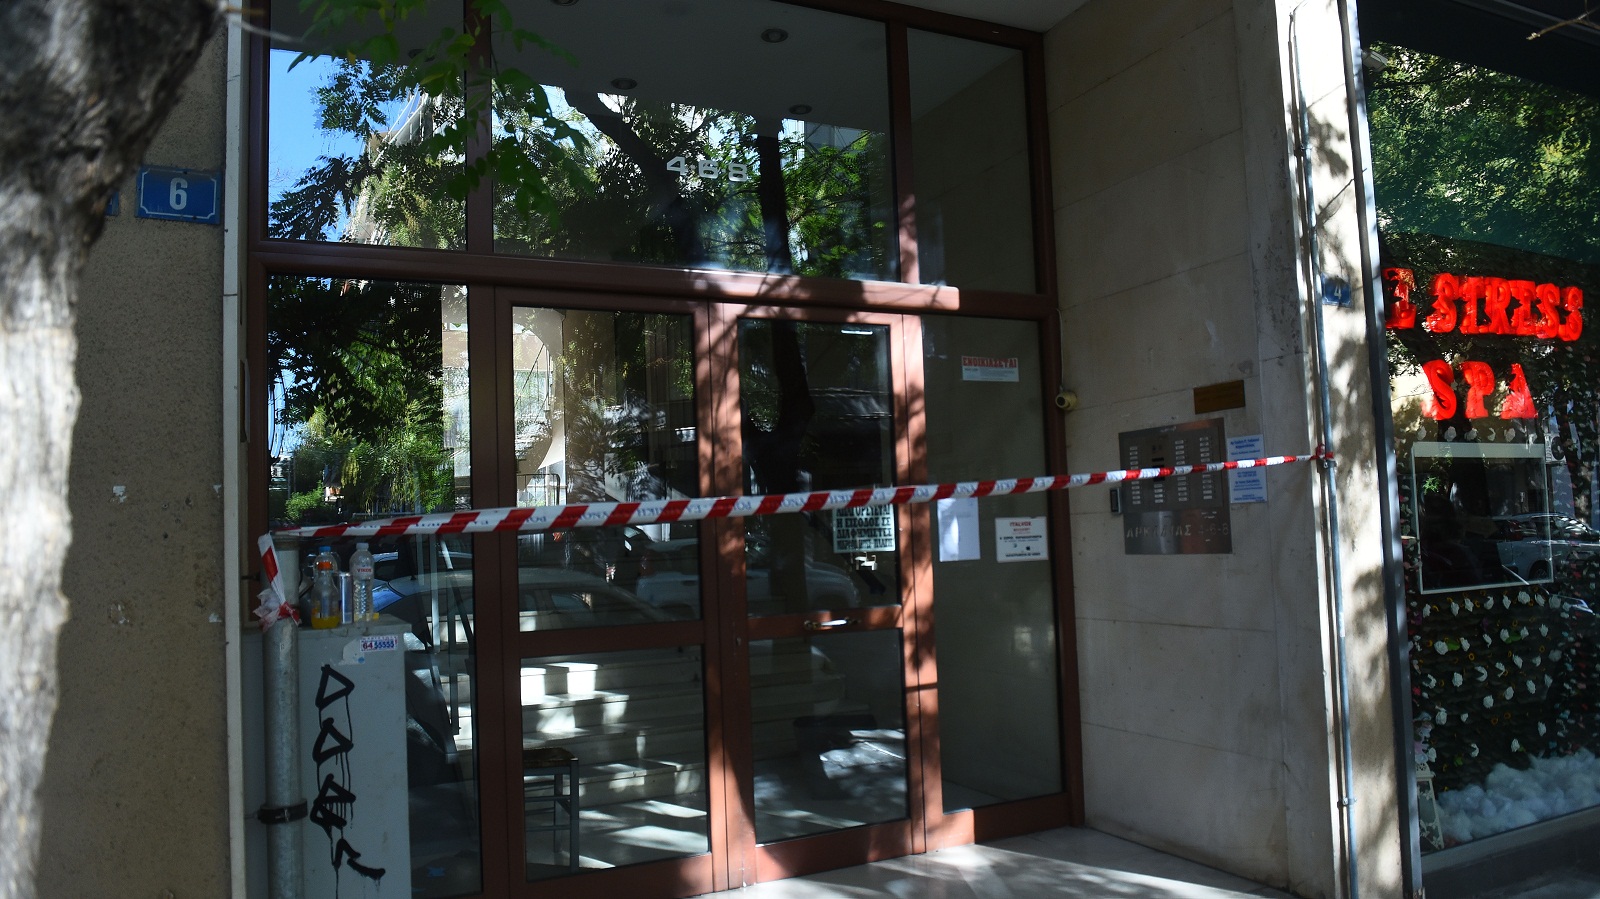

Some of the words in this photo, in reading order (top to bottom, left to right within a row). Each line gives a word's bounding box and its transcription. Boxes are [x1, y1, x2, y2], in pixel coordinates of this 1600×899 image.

[169, 177, 188, 210] 6
[1333, 285, 1342, 300] 4
[1427, 272, 1584, 342] STRESS
[1421, 359, 1538, 421] SPA
[836, 518, 843, 528] Η
[845, 517, 880, 528] ΕΙΣΟΔΟΣ
[881, 517, 891, 526] ΣΕ
